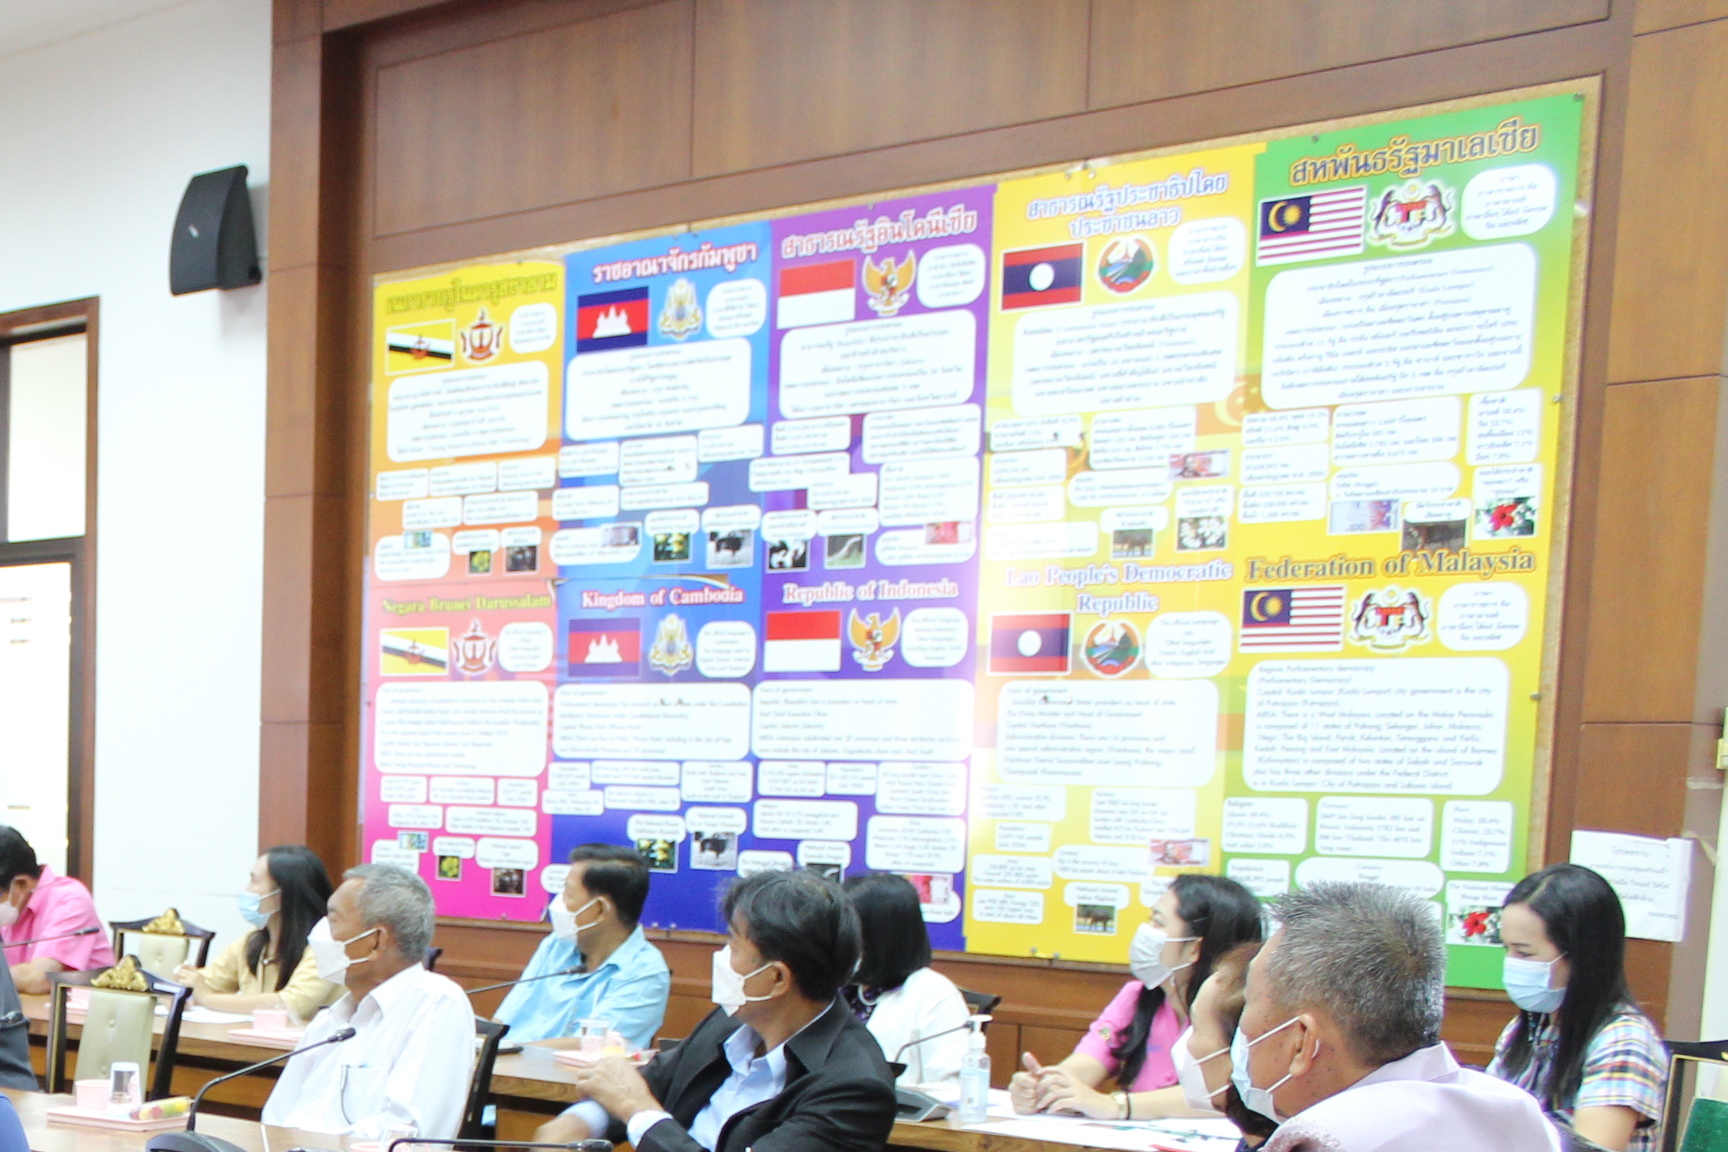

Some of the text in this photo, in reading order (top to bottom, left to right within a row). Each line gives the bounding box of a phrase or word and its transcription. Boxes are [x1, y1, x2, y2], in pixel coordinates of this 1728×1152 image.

[1005, 560, 1233, 588] Lao People's Democratic
[1247, 549, 1536, 581] Federation of Malaysia
[581, 586, 745, 611] Kingdom of Cambodia
[783, 578, 959, 607] Republic of Indonesia
[1076, 592, 1159, 617] Republic
[382, 598, 425, 616] Negara
[429, 597, 471, 612] Brunei
